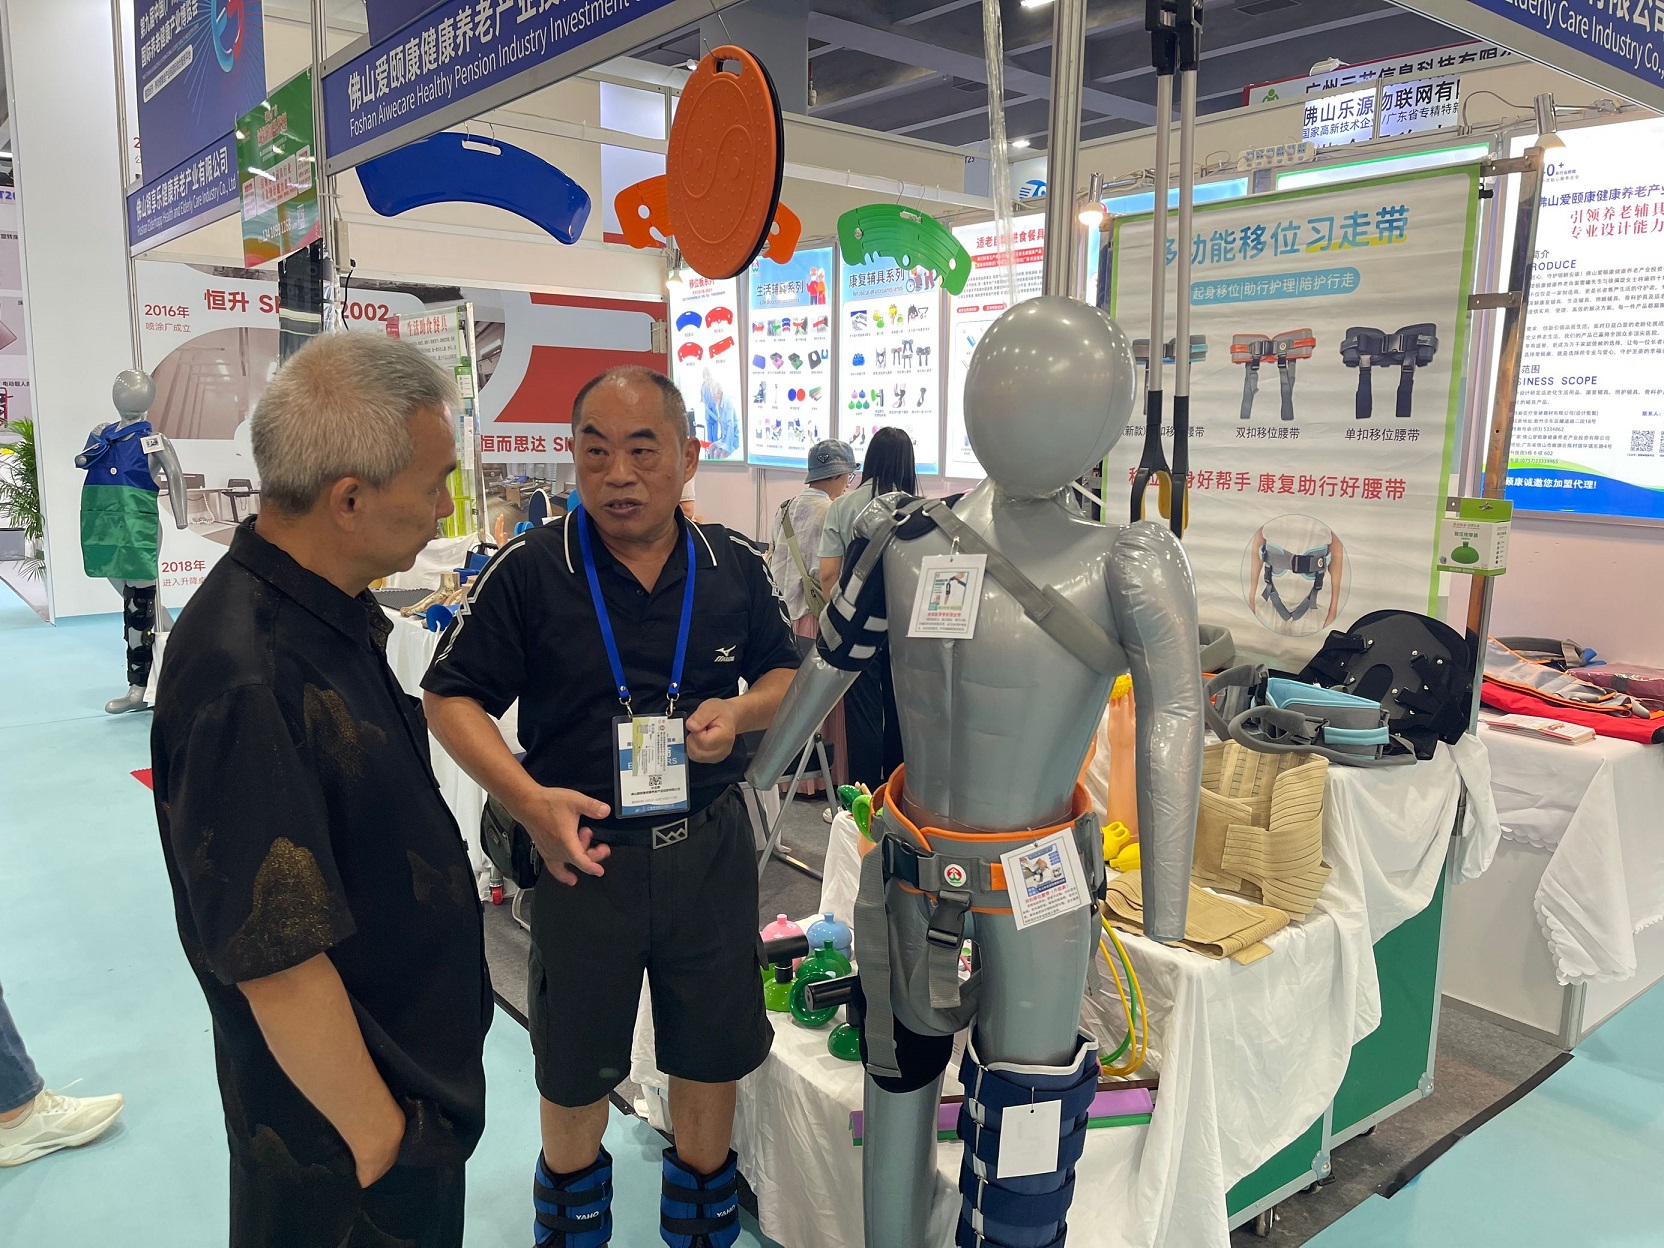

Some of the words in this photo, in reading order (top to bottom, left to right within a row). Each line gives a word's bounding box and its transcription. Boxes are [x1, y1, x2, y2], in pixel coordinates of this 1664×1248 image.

[1558, 2, 1589, 39] Care
[1591, 15, 1644, 70] Industry
[350, 107, 378, 138] Foshan
[378, 90, 416, 123] Aiwecare
[416, 73, 453, 106] Healthy
[454, 54, 497, 89] Pension
[498, 27, 548, 62] Industry
[1304, 80, 1461, 127] 佛山乐源物联网有
[848, 267, 905, 288] 康复辅具系列
[756, 280, 804, 297] 生活辅具系列
[144, 304, 190, 319] 2016年
[203, 289, 250, 313] 恒升
[340, 300, 389, 322] 2002
[145, 322, 191, 333] 喷涂厂成立
[1561, 376, 1598, 385] SCOPE
[1235, 427, 1301, 440] 双扣移位腰带
[1344, 428, 1421, 442] 单扣移位腰带
[480, 435, 547, 453] 恒而思达
[1257, 473, 1406, 501] 康复助行好腰带
[161, 560, 206, 573] 2018年
[575, 1210, 600, 1221] YAHO
[716, 1204, 736, 1218] YAHO
